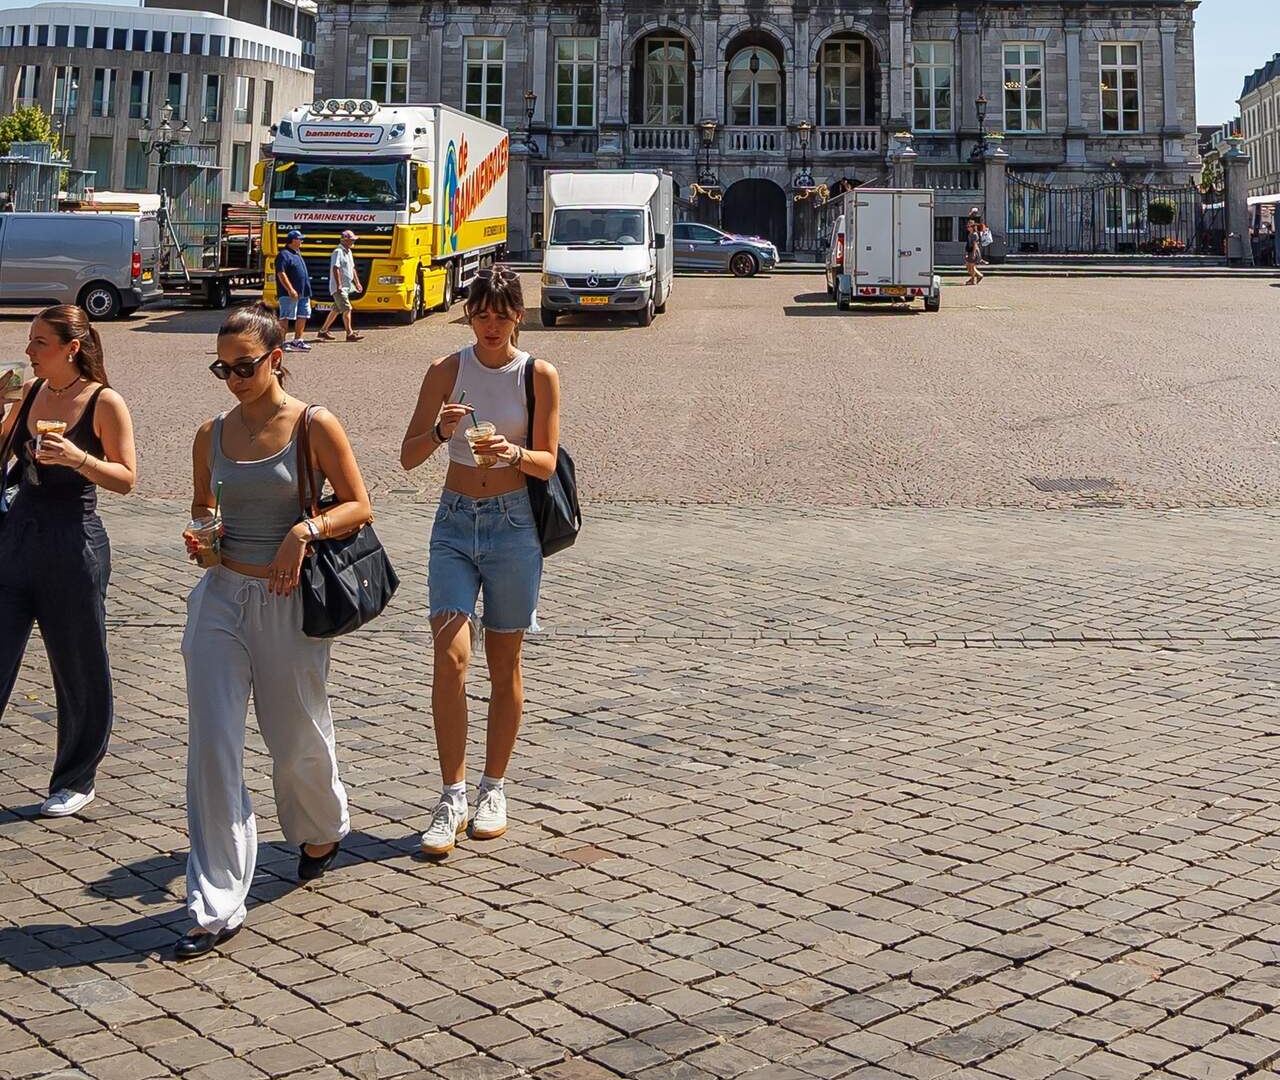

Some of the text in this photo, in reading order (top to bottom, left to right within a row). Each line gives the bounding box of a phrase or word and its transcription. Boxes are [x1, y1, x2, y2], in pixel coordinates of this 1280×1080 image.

[305, 129, 375, 139] bananenboxer
[457, 131, 468, 178] de
[453, 134, 509, 233] BANANENBOXER
[293, 212, 376, 222] VITAMINENTRUCK
